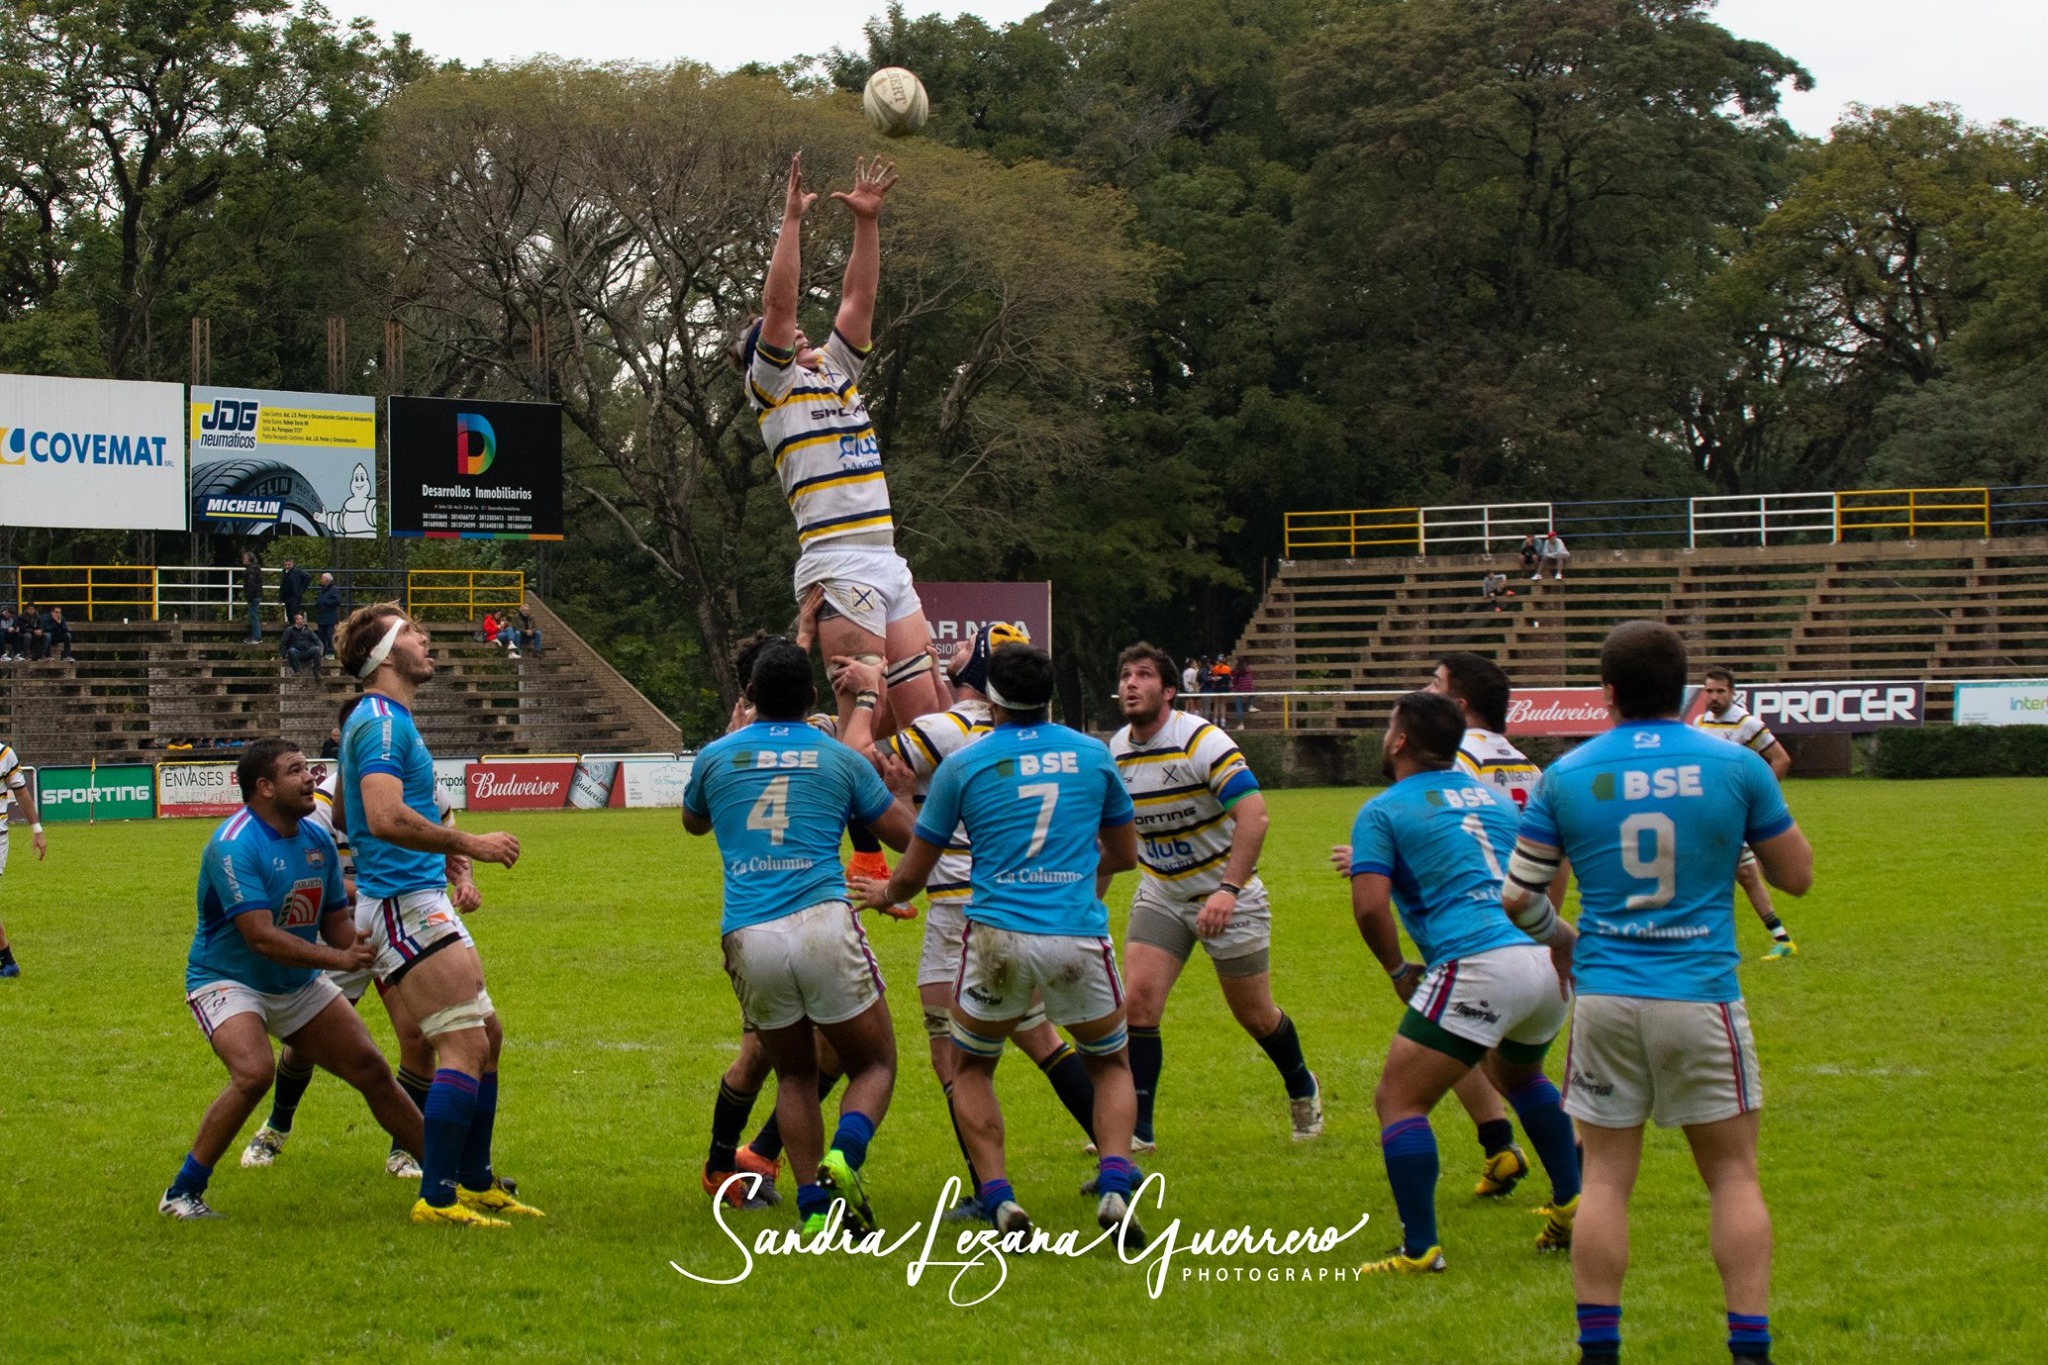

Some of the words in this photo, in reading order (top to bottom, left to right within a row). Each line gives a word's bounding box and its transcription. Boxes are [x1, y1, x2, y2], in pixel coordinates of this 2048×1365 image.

[201, 399, 258, 431] JDG
[30, 431, 166, 466] COVEMAT
[422, 484, 471, 498] Desarrollos
[475, 486, 532, 500] Inmobiliarios
[207, 499, 280, 513] MICHELIN
[1505, 699, 1609, 723] Budweiser
[1753, 687, 1916, 724] PROCER
[2010, 696, 2048, 711] inter
[757, 751, 818, 768] BSE
[1019, 752, 1079, 776] BSE
[165, 771, 224, 787] ENVASES
[471, 772, 559, 798] Budweiser
[1624, 765, 1703, 800] BSE
[42, 785, 149, 804] SPORTING
[1442, 788, 1497, 808] BSE
[746, 776, 790, 845] 4
[1018, 783, 1059, 858] 7
[1135, 806, 1196, 825] ORTING
[749, 855, 813, 871] Columna
[1620, 812, 1675, 910] 9
[1623, 922, 1710, 939] Columna
